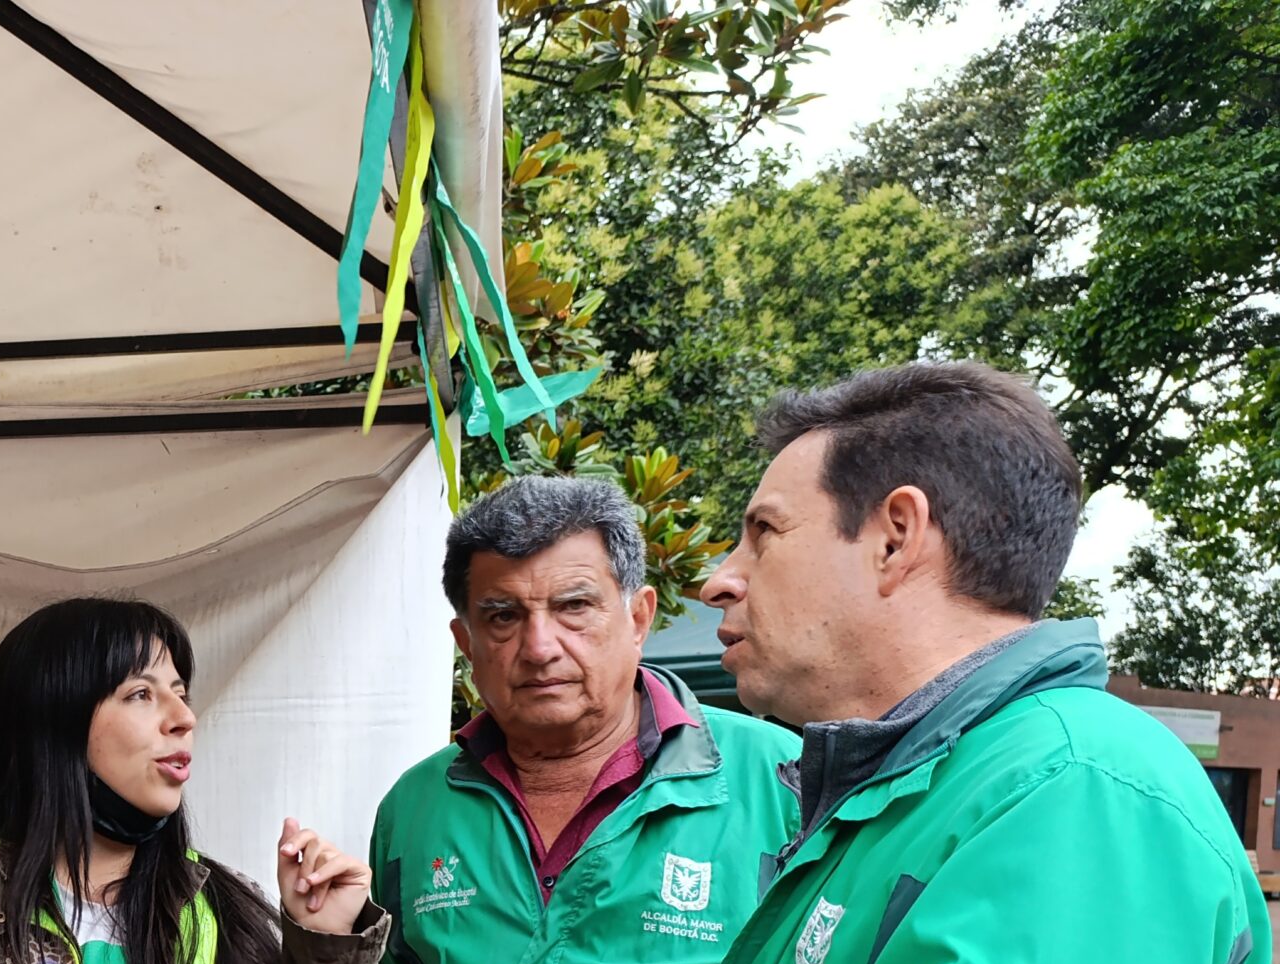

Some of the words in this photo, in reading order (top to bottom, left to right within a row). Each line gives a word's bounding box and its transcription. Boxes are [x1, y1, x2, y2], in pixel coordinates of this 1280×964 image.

[641, 911, 688, 926] ALCALDÍA
[690, 919, 723, 931] MAYOR
[643, 922, 656, 932] DE
[659, 924, 699, 938] BOGOTÁ
[701, 932, 719, 942] D.C.
